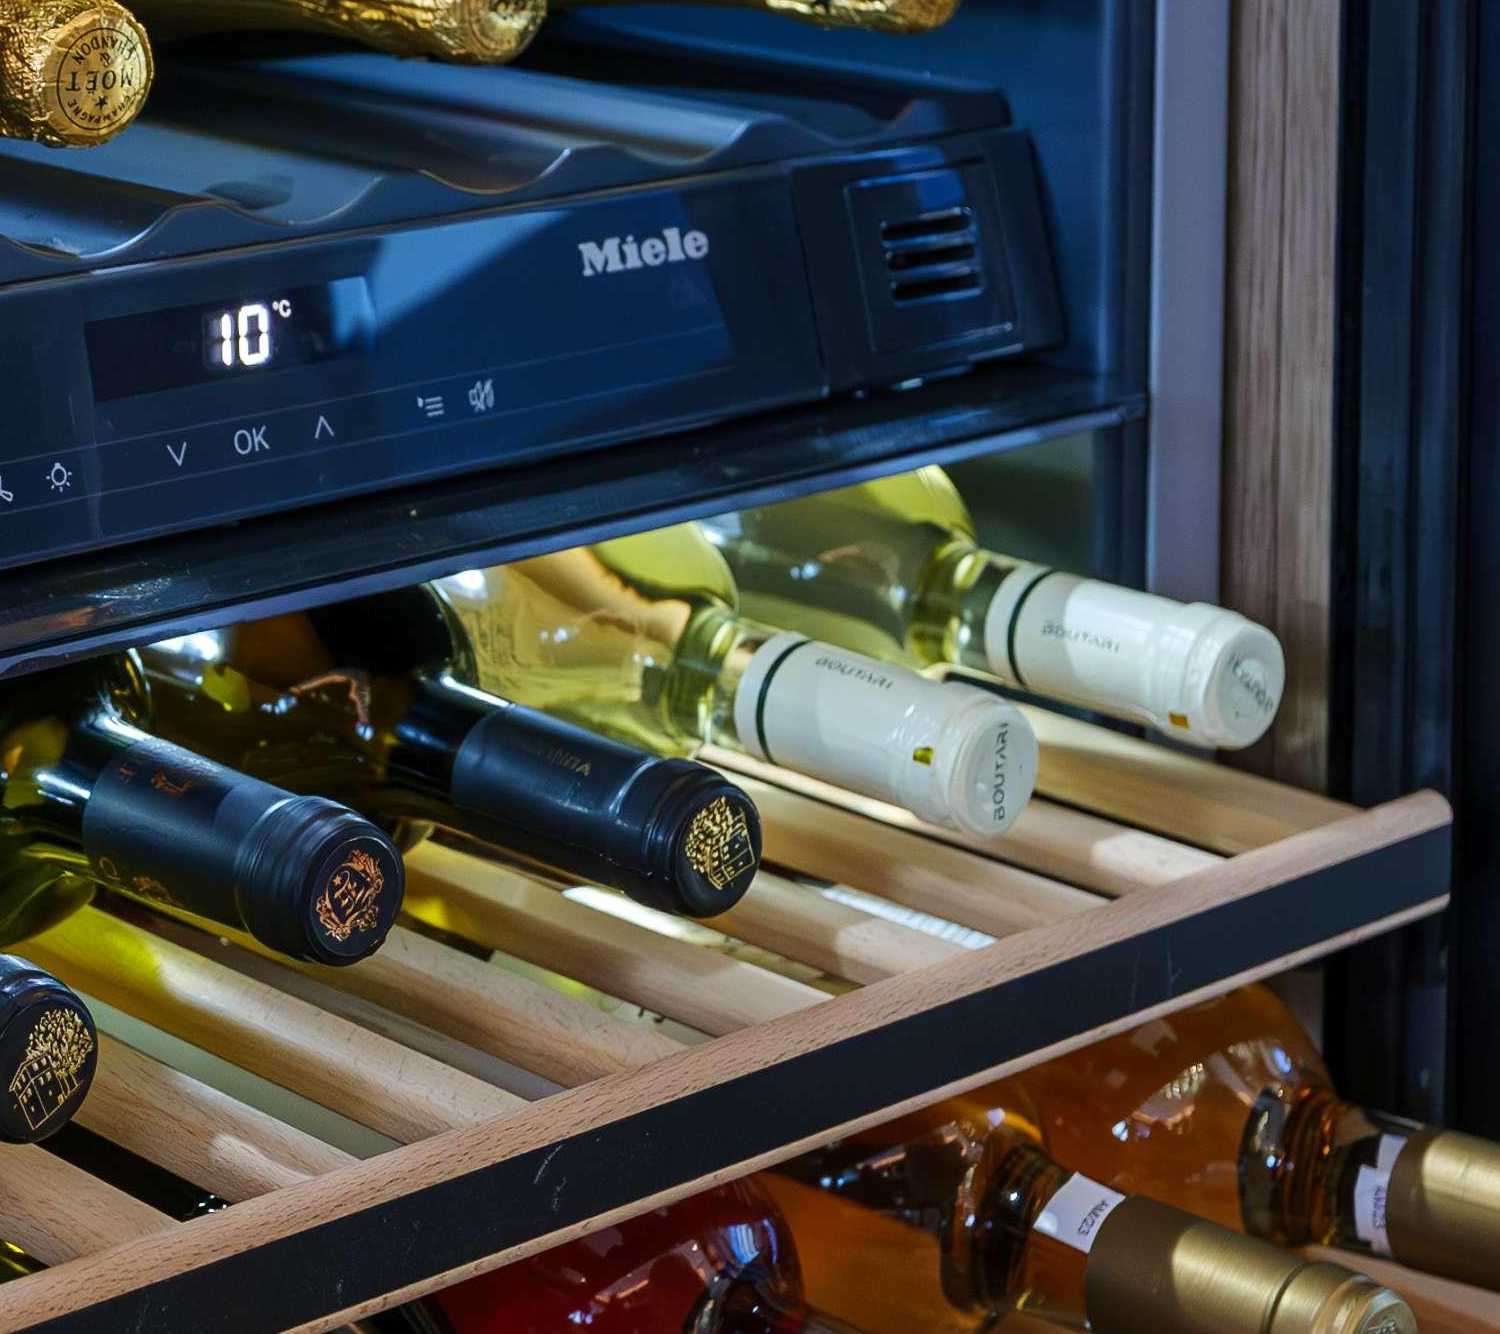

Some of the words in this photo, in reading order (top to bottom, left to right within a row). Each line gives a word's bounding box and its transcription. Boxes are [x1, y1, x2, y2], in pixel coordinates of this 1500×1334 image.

[72, 35, 136, 66] CHANDON
[99, 51, 112, 68] &
[65, 67, 134, 96] MOËT
[66, 94, 132, 125] CHAMPAGNE
[578, 227, 709, 276] Miele
[233, 427, 269, 455] OK
[815, 657, 894, 691] BOUTARI
[992, 722, 1009, 822] BOUTARI
